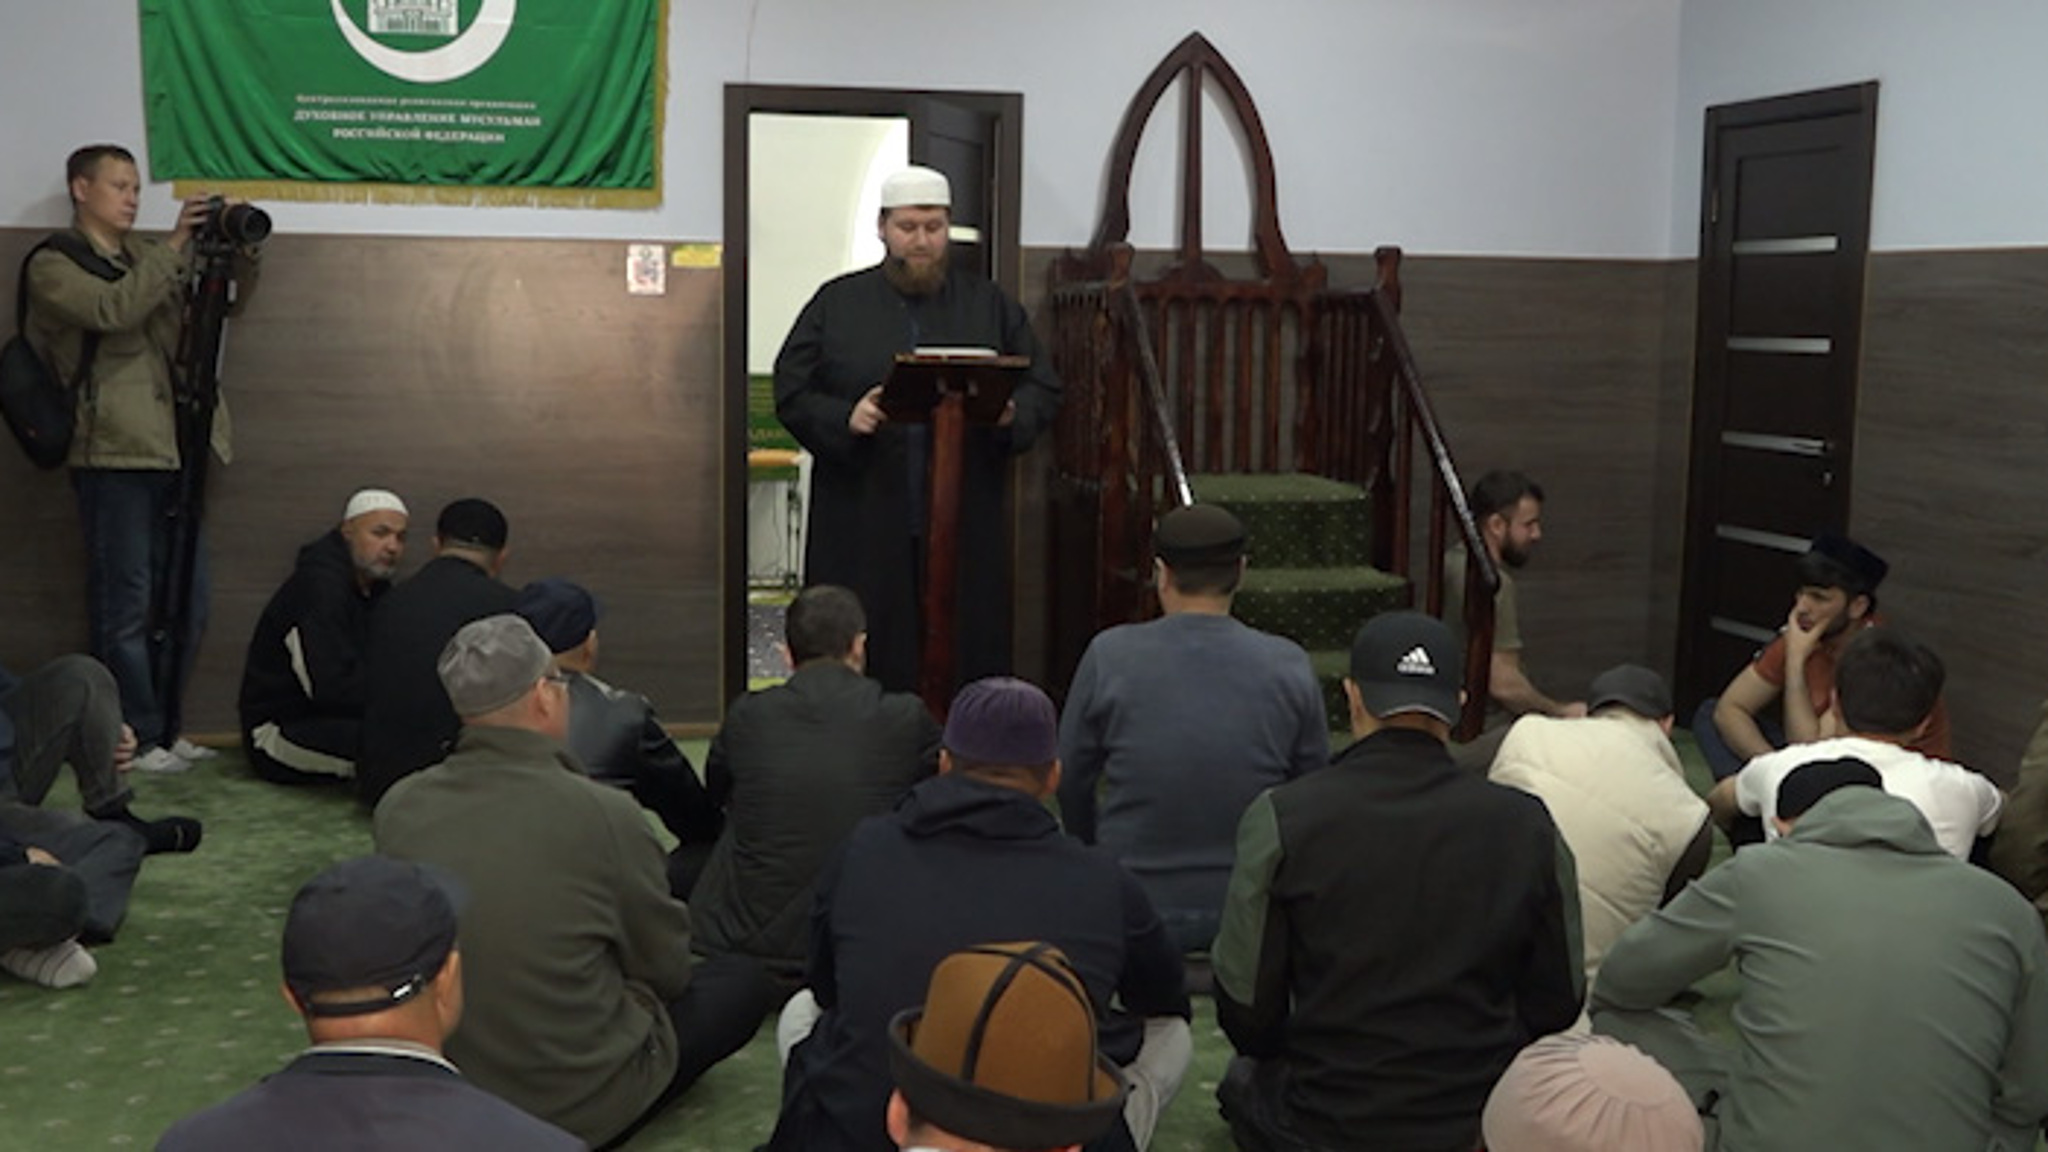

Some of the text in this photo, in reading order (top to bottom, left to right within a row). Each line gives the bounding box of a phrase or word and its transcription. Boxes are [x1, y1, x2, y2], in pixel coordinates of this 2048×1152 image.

[294, 110, 541, 126] ДУХОВНОЕ УПРАВЛЕНИЕ МУСУЛЬМАН
[332, 126, 505, 142] РОССИЙСКОЙ ФЕДЕРАЦИИ
